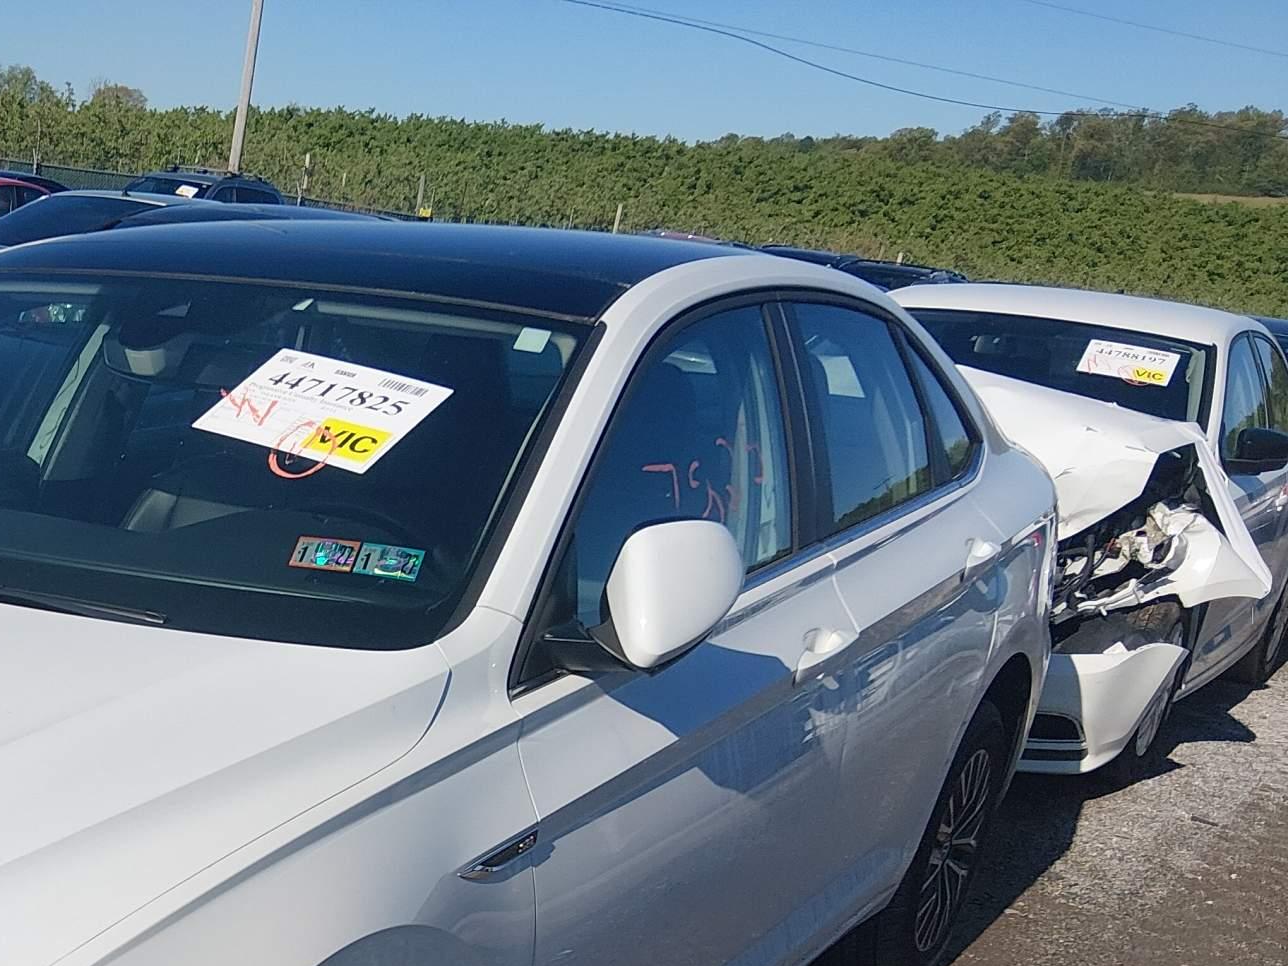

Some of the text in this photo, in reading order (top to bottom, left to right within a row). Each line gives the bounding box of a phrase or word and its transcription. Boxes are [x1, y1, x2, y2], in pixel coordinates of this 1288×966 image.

[1095, 348, 1166, 365] 44788197
[1135, 369, 1164, 381] VIC
[268, 371, 411, 416] 44717825
[319, 426, 379, 454] VIC
